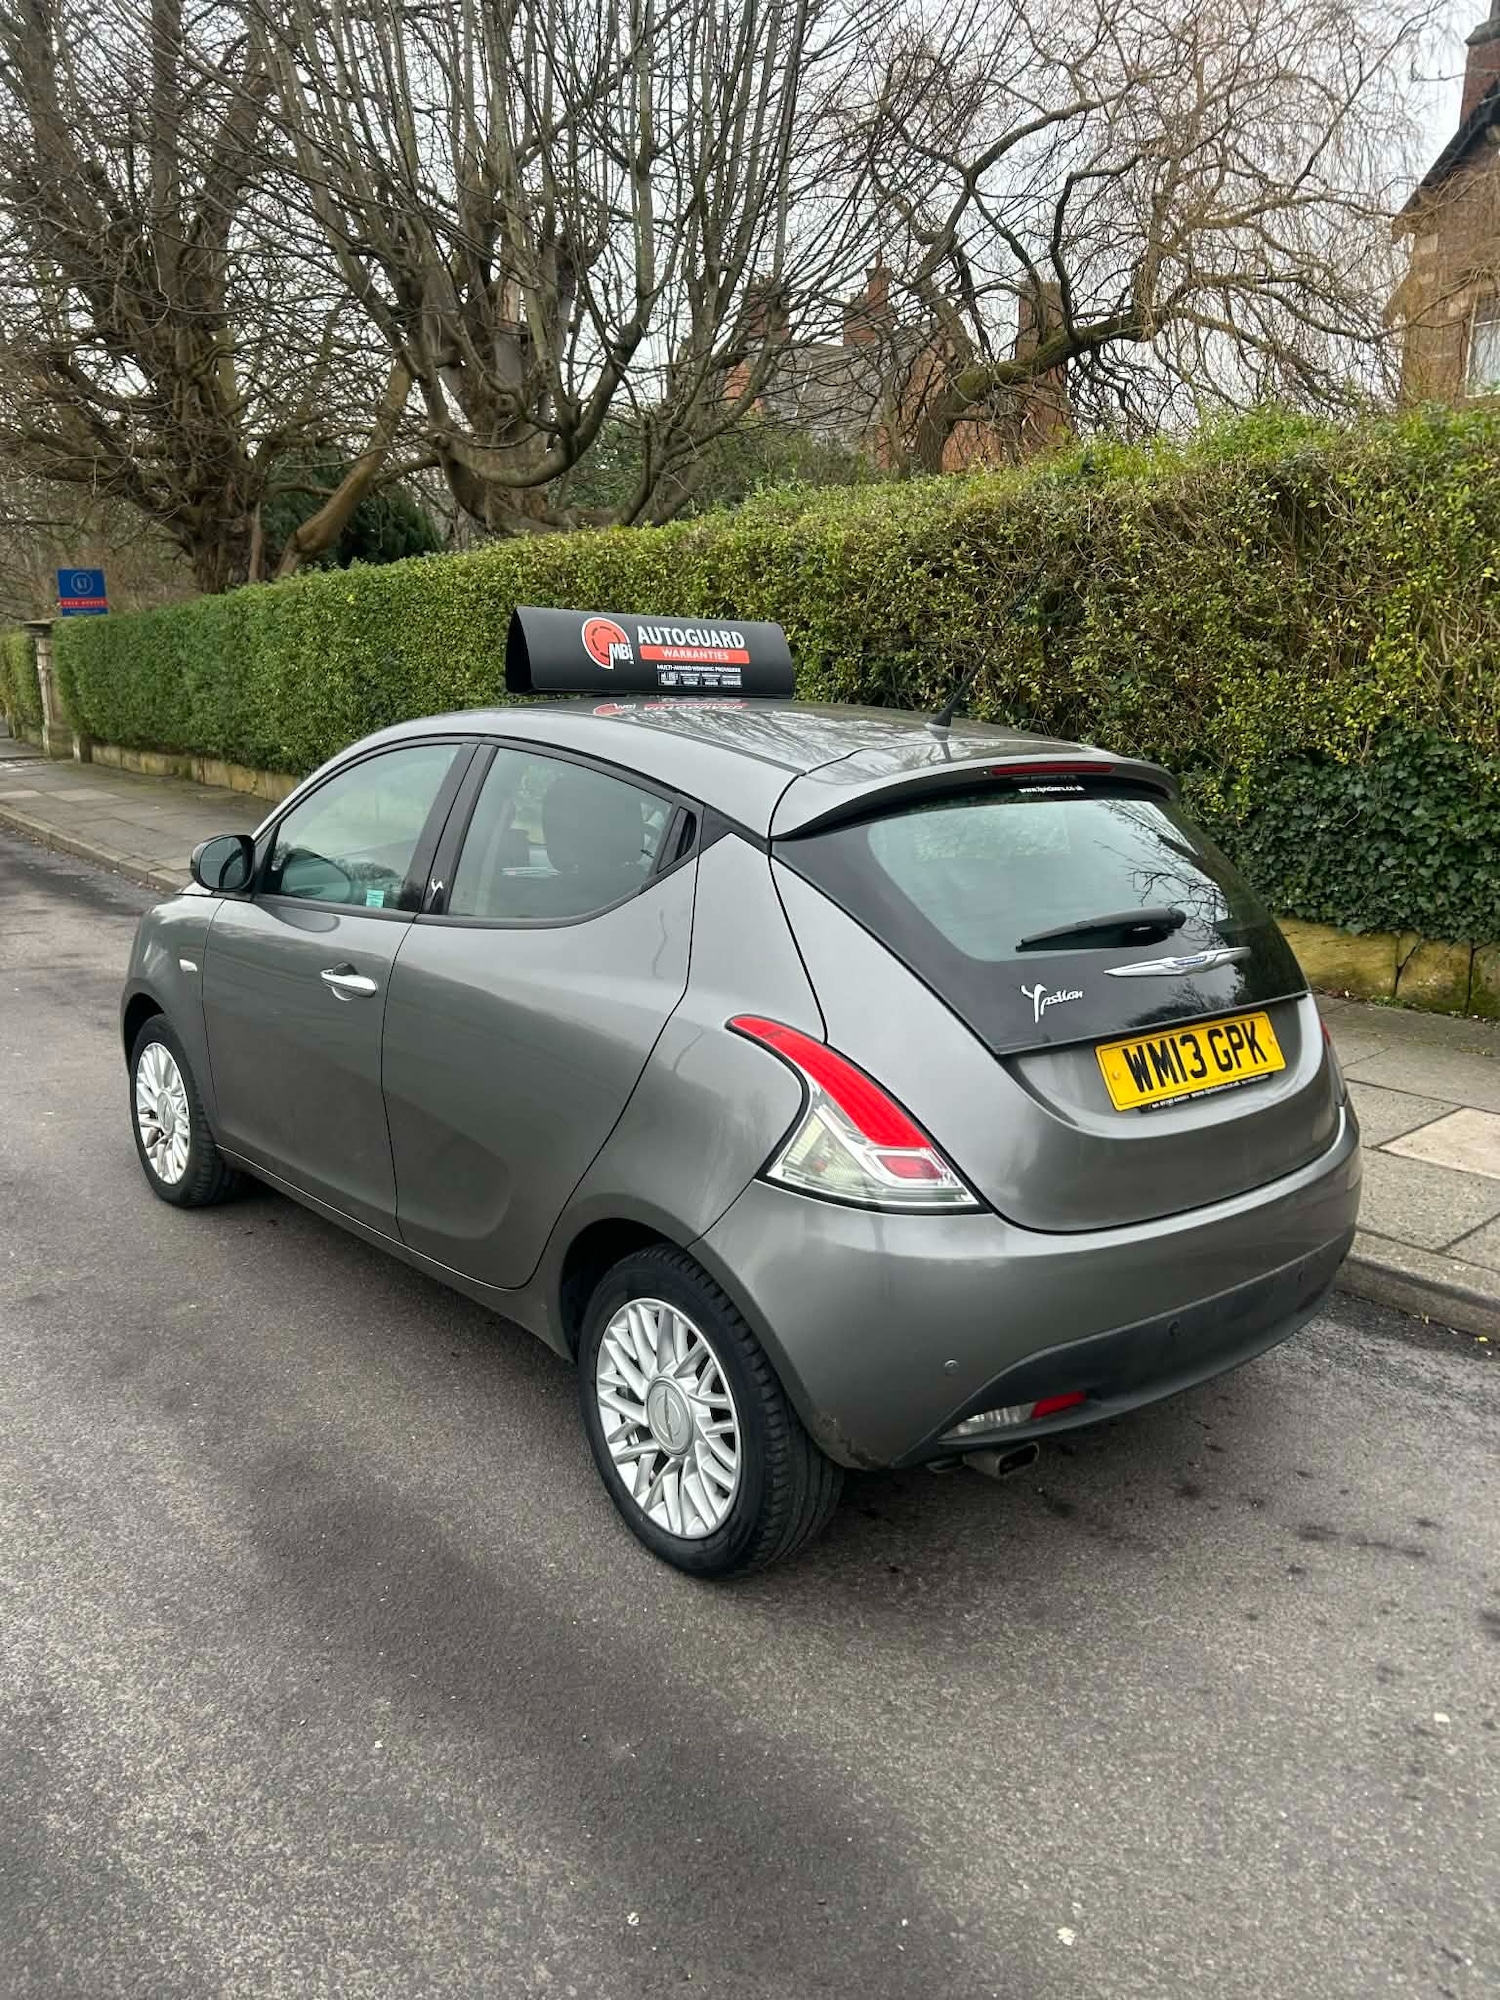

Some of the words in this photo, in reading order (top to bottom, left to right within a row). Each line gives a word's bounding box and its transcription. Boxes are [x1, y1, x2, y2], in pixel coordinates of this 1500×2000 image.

[637, 625, 745, 649] AUTOGUARD
[662, 648, 730, 661] WARRANTIES
[1020, 983, 1084, 1024] Ypsilon
[1122, 1033, 1208, 1093] WM13
[1208, 1021, 1268, 1072] GPK
